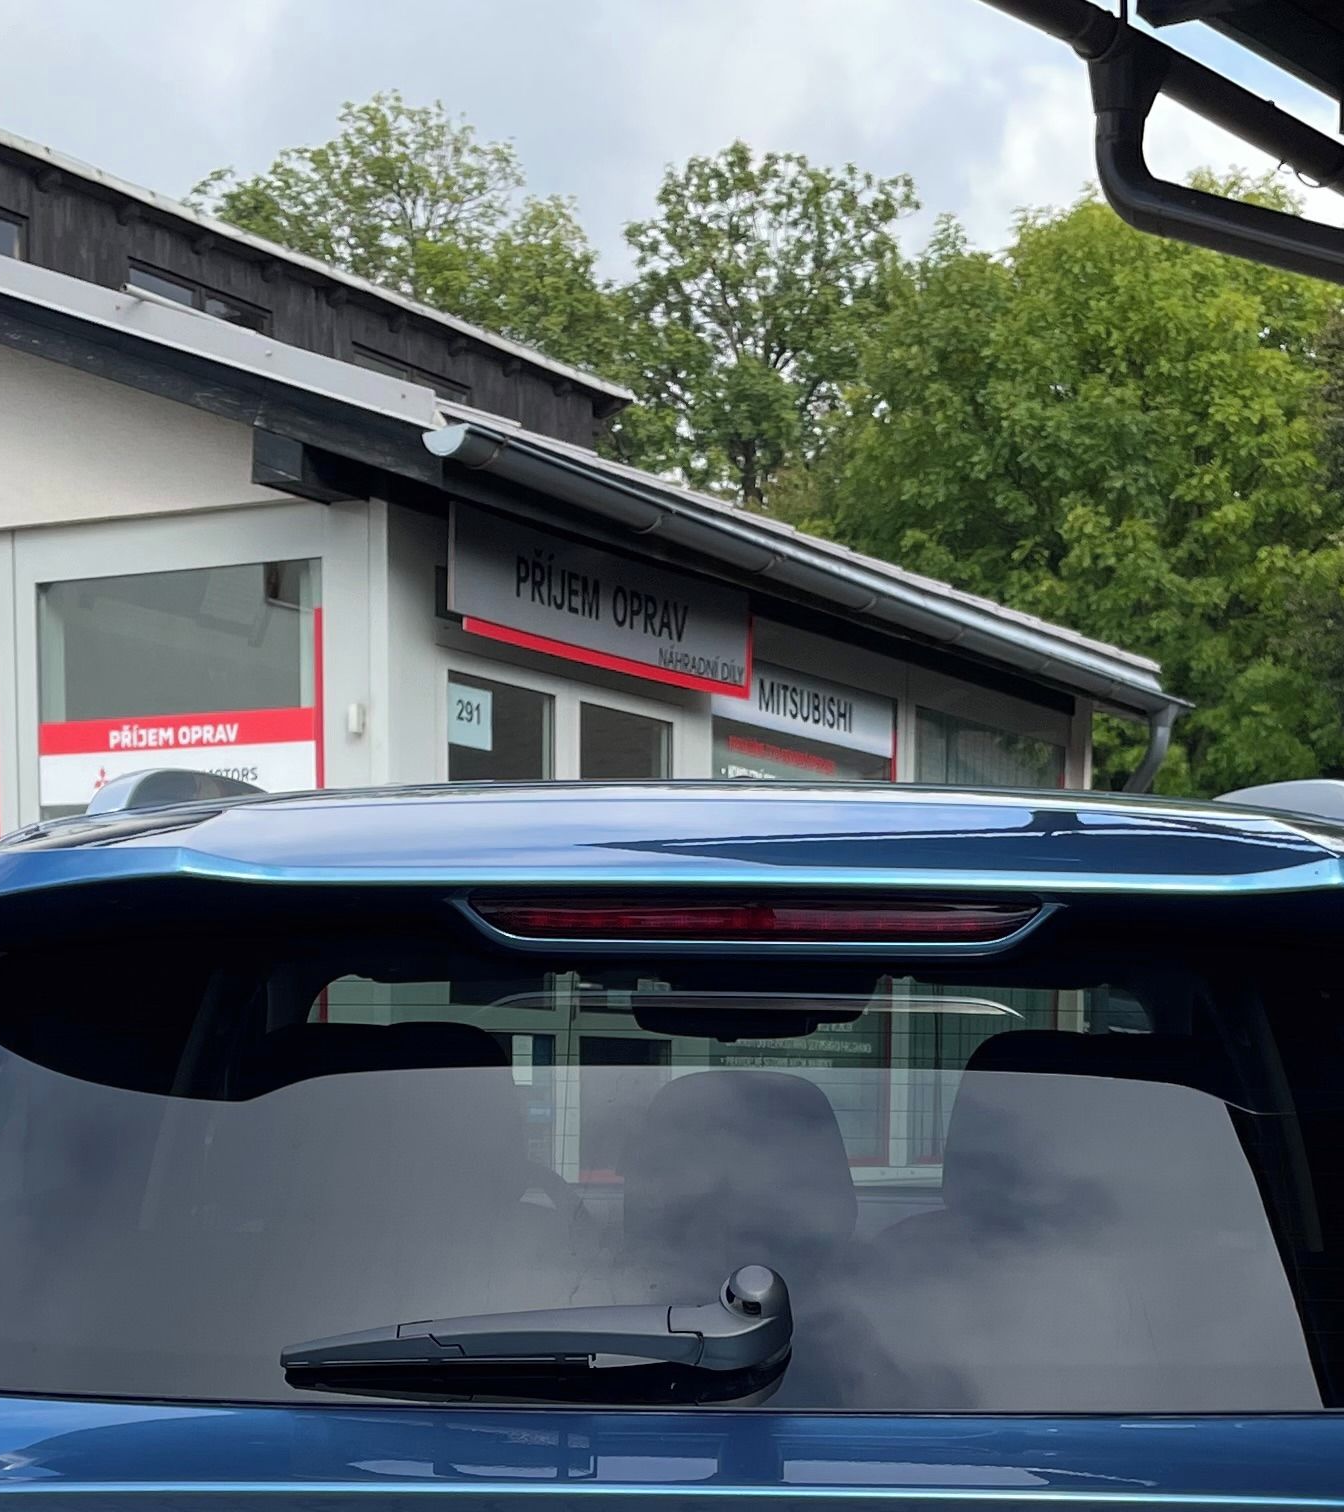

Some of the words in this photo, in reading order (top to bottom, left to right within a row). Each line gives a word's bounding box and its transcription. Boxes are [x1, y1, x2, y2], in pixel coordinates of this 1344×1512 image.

[515, 549, 600, 621] PŘÍJEM
[612, 585, 689, 643] OPRAV
[456, 699, 481, 725] 291
[758, 679, 853, 734] MITSUBISHI
[109, 723, 174, 749] PŘÍJEM
[178, 723, 239, 745] OPRAV
